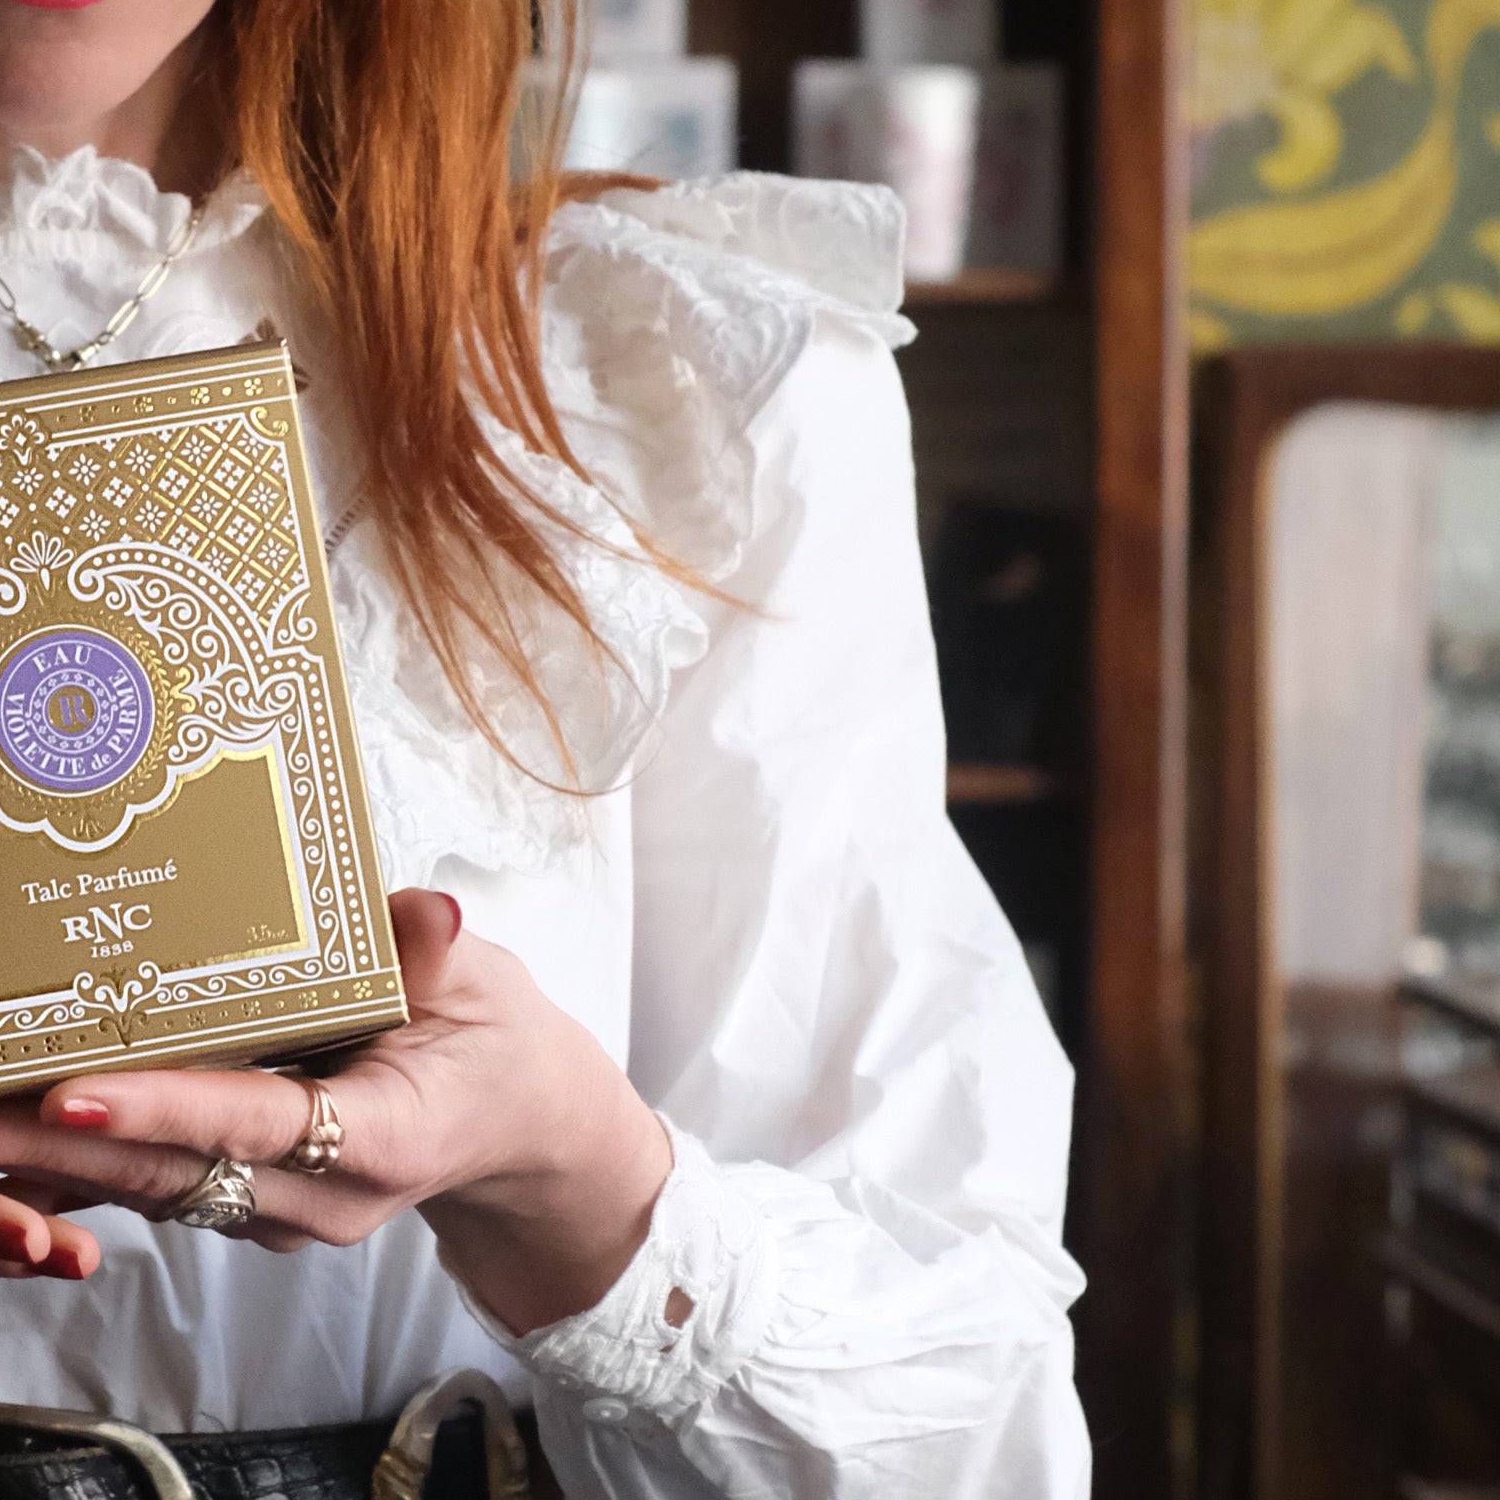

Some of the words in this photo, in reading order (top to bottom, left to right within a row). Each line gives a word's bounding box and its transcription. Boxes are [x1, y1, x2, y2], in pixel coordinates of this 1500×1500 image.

[32, 645, 92, 673] EAU
[5, 693, 86, 775] VIOLETTE
[91, 753, 112, 771] de
[106, 669, 138, 755] PARME
[58, 694, 88, 726] R
[21, 879, 72, 904] Talc
[76, 858, 178, 896] Parfumé
[60, 902, 152, 943] RNC
